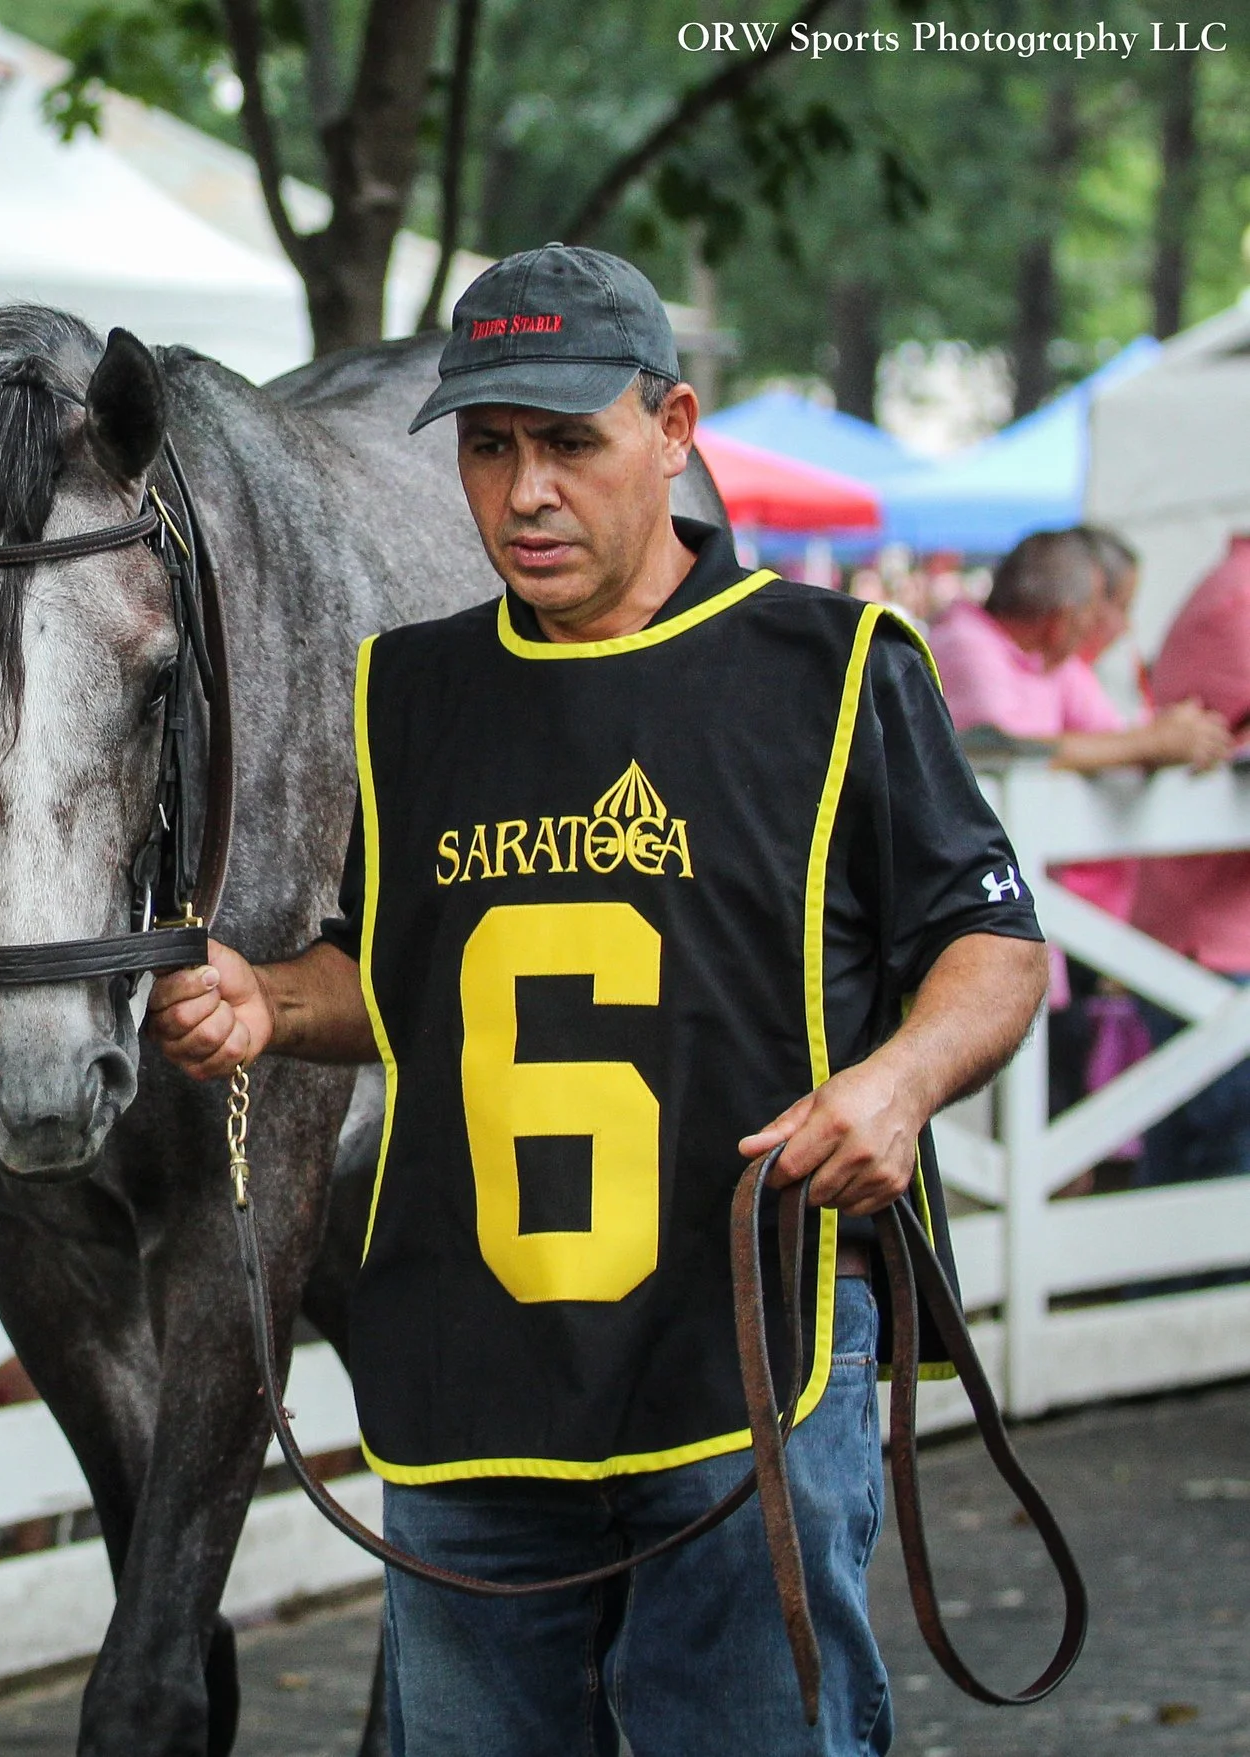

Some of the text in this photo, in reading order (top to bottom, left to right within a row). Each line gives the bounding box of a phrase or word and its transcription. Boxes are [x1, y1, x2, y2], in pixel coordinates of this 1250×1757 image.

[510, 314, 563, 334] STABLE
[436, 815, 694, 885] SARATOGA
[459, 902, 662, 1304] 6
